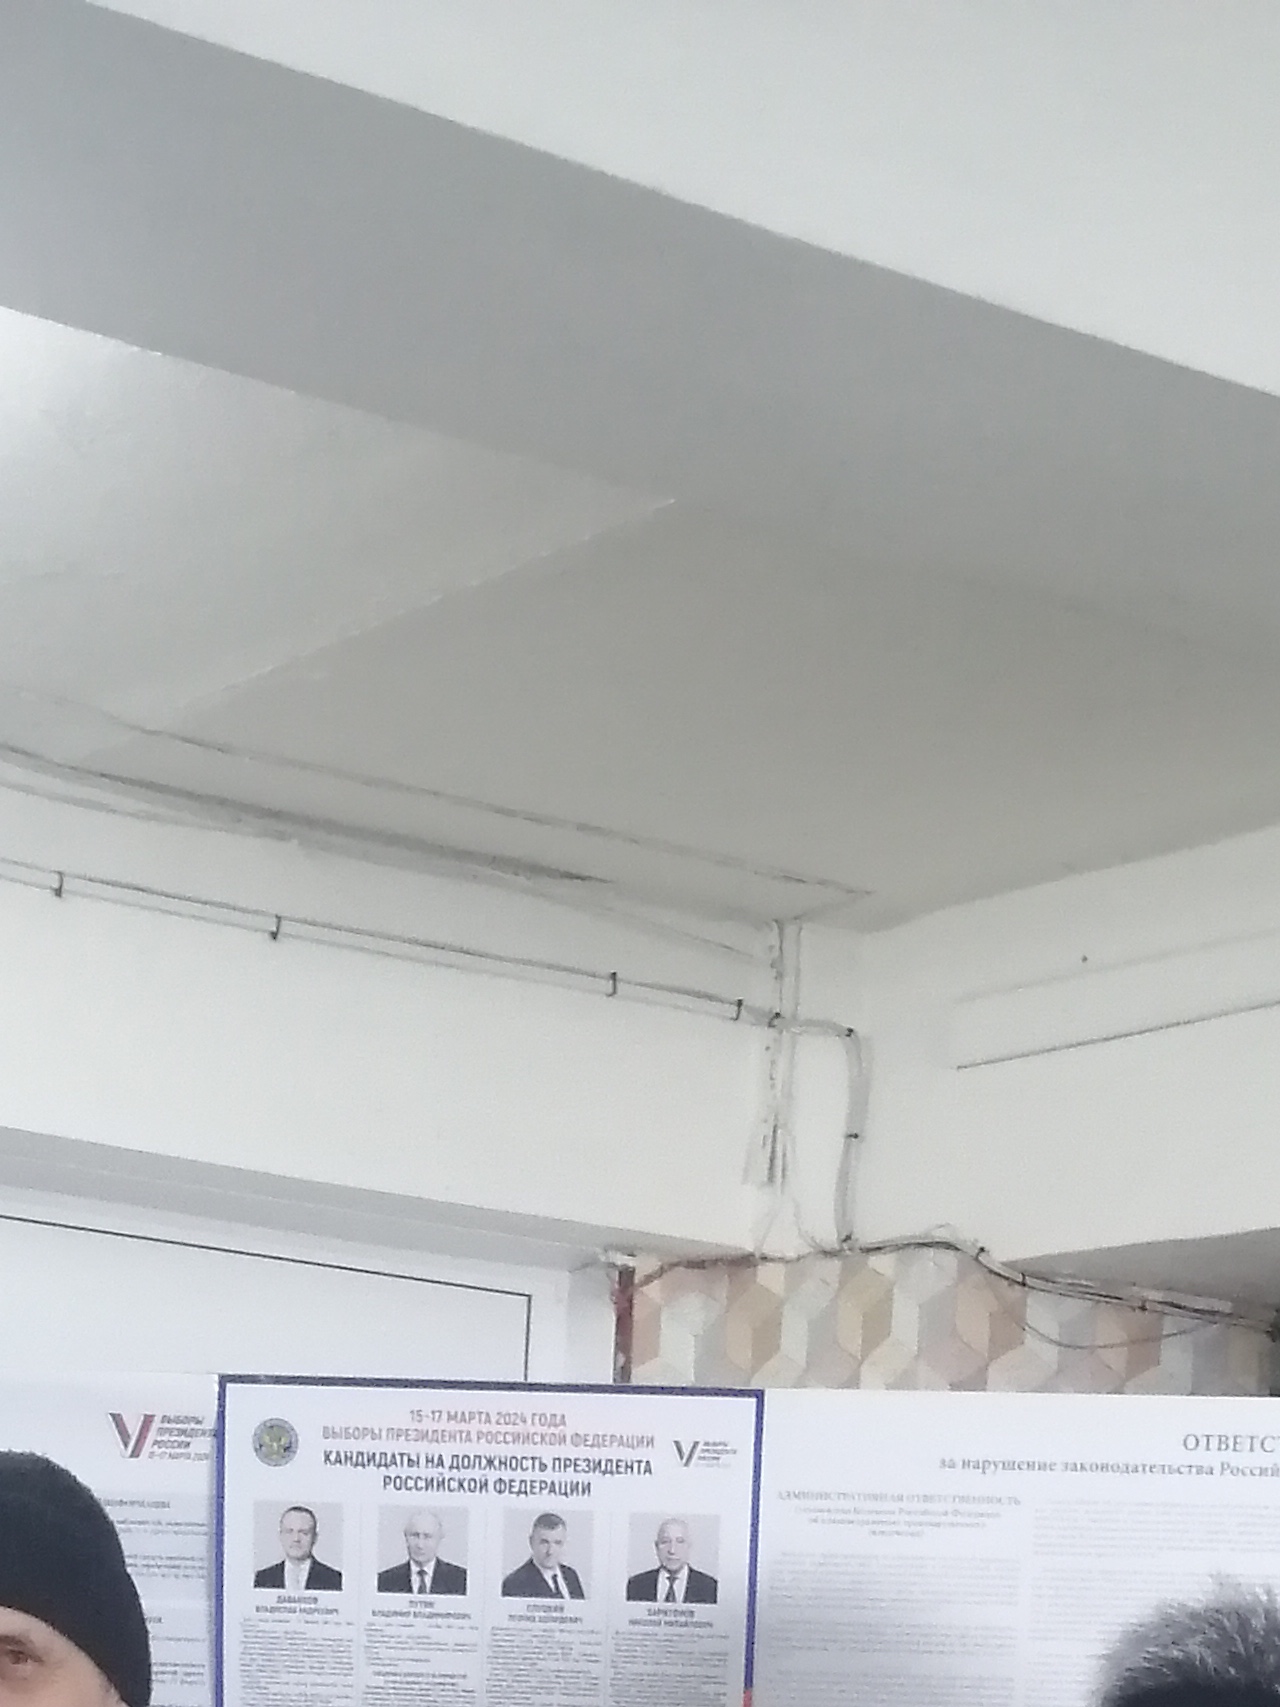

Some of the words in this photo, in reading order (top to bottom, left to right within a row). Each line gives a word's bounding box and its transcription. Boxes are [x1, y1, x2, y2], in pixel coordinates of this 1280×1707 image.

[409, 1410, 442, 1424] 15-17
[447, 1411, 492, 1426] МАРТА
[496, 1412, 527, 1427] 2024
[531, 1413, 567, 1428] ГОДА
[322, 1426, 382, 1441] ВЫБОРЫ
[385, 1427, 472, 1444] ПРЕЗИДЕНТА
[476, 1429, 567, 1446] РОССИЙСКОЙ
[571, 1433, 655, 1450] ФЕДЕРАЦИИ
[323, 1450, 420, 1469] КАНДИДАТЫ
[425, 1453, 445, 1469] НА
[448, 1454, 547, 1473] ДОЛЖНОСТЬ
[552, 1457, 653, 1476] ПРЕЗИДЕНТА
[939, 1457, 957, 1470] за
[961, 1458, 1056, 1476] нарушение
[1061, 1460, 1215, 1477] законодательства
[383, 1472, 489, 1494] РОССИЙСКОЙ
[493, 1477, 592, 1497] ФЕДЕРАЦИИ
